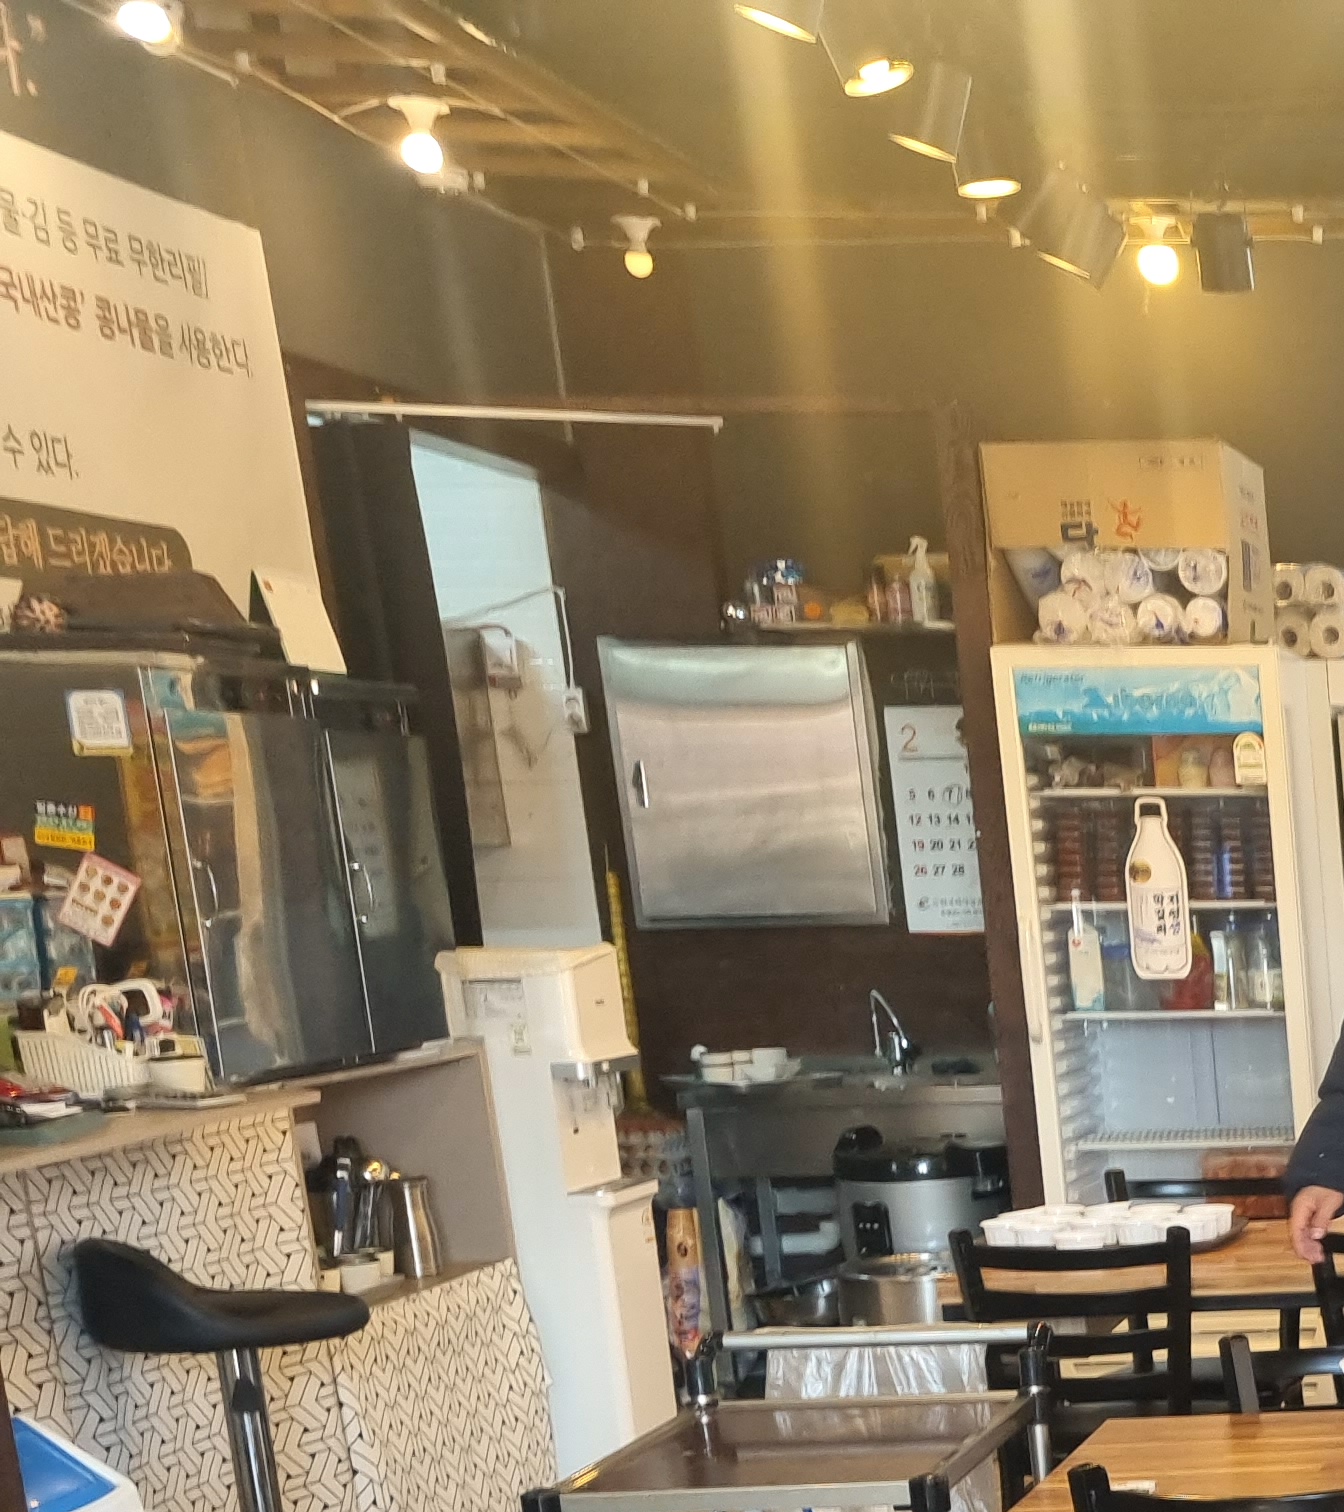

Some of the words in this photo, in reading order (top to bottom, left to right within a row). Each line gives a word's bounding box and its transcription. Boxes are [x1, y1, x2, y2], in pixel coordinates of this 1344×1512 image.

[56, 205, 79, 256] 등
[82, 216, 125, 268] 무료
[95, 293, 176, 359] 콩나물을
[2, 423, 25, 470] 수
[30, 428, 80, 481] 있다.
[901, 724, 918, 752] 2
[909, 814, 922, 827] 12
[927, 814, 941, 827] 13
[946, 814, 960, 827] 14
[912, 839, 925, 852] 19
[929, 839, 943, 851] 20
[949, 838, 962, 851] 21
[914, 864, 928, 877] 26
[932, 864, 946, 877] 27
[952, 864, 965, 876] 28
